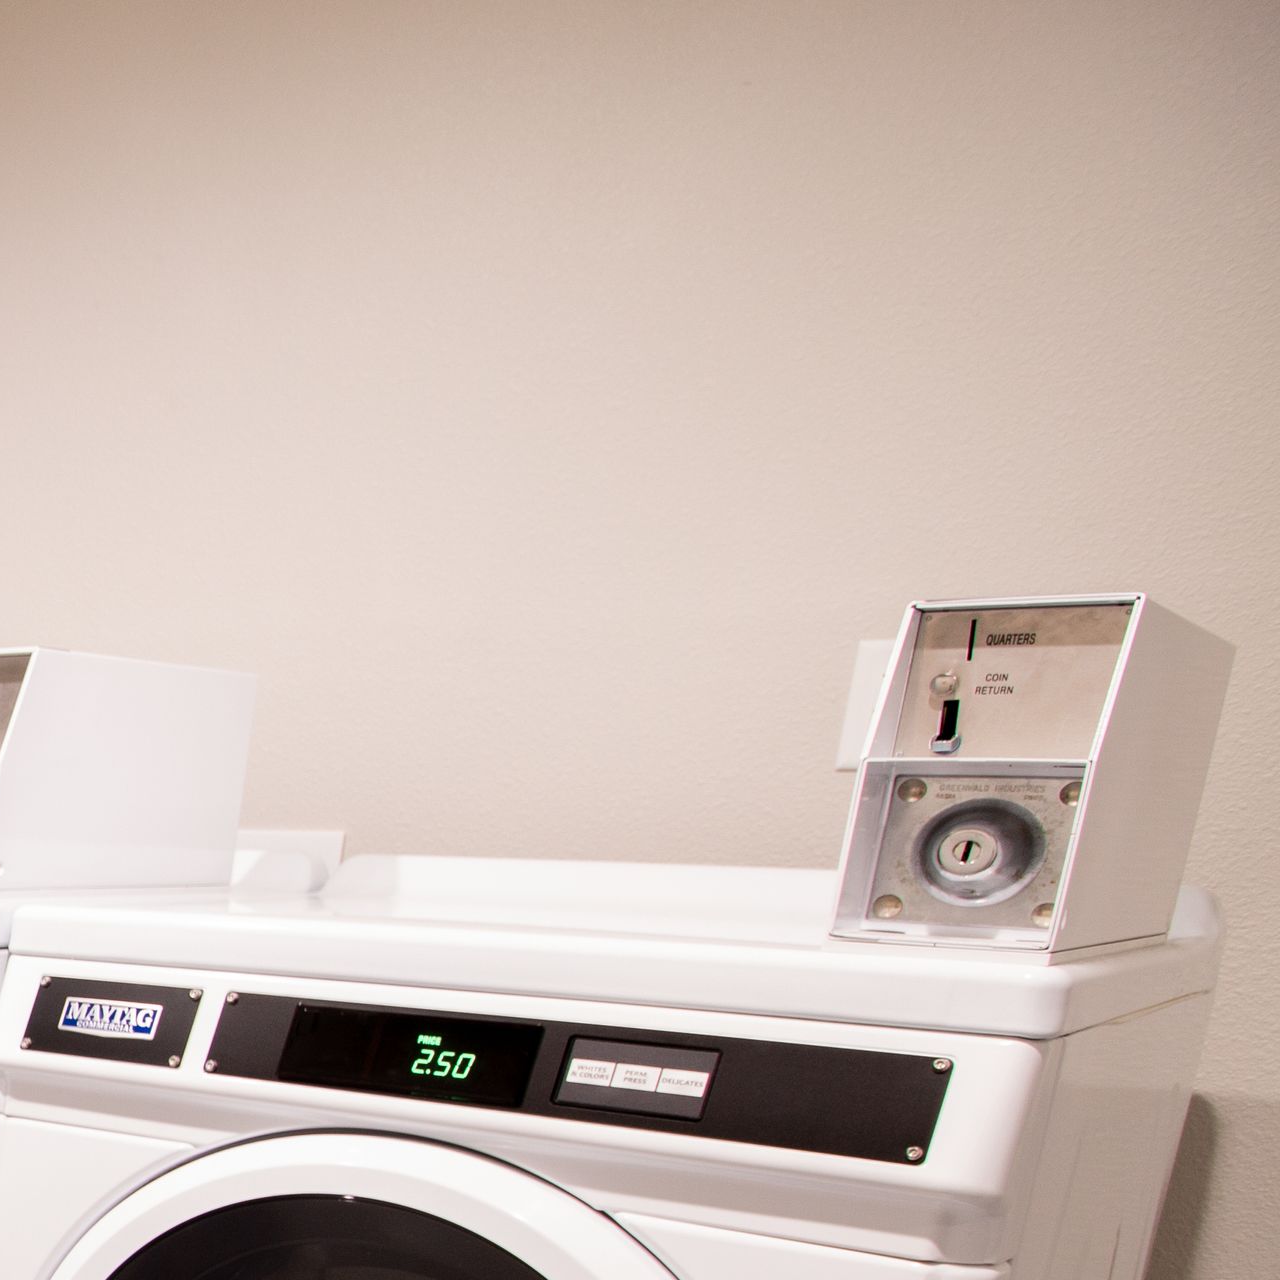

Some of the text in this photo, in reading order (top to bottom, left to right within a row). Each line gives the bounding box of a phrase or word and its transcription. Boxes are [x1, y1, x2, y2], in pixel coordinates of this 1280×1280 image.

[985, 632, 1037, 646] QUARTERS
[985, 673, 1009, 682] COIN
[975, 686, 1014, 695] RETURN
[66, 1001, 156, 1028] MAYTAG
[417, 1034, 442, 1046] PRICE
[411, 1048, 476, 1079] 2.50
[577, 1065, 607, 1073] WHITES
[579, 1071, 609, 1081] COLORS
[623, 1077, 647, 1085] PRESS
[661, 1077, 704, 1088] DELICATES
